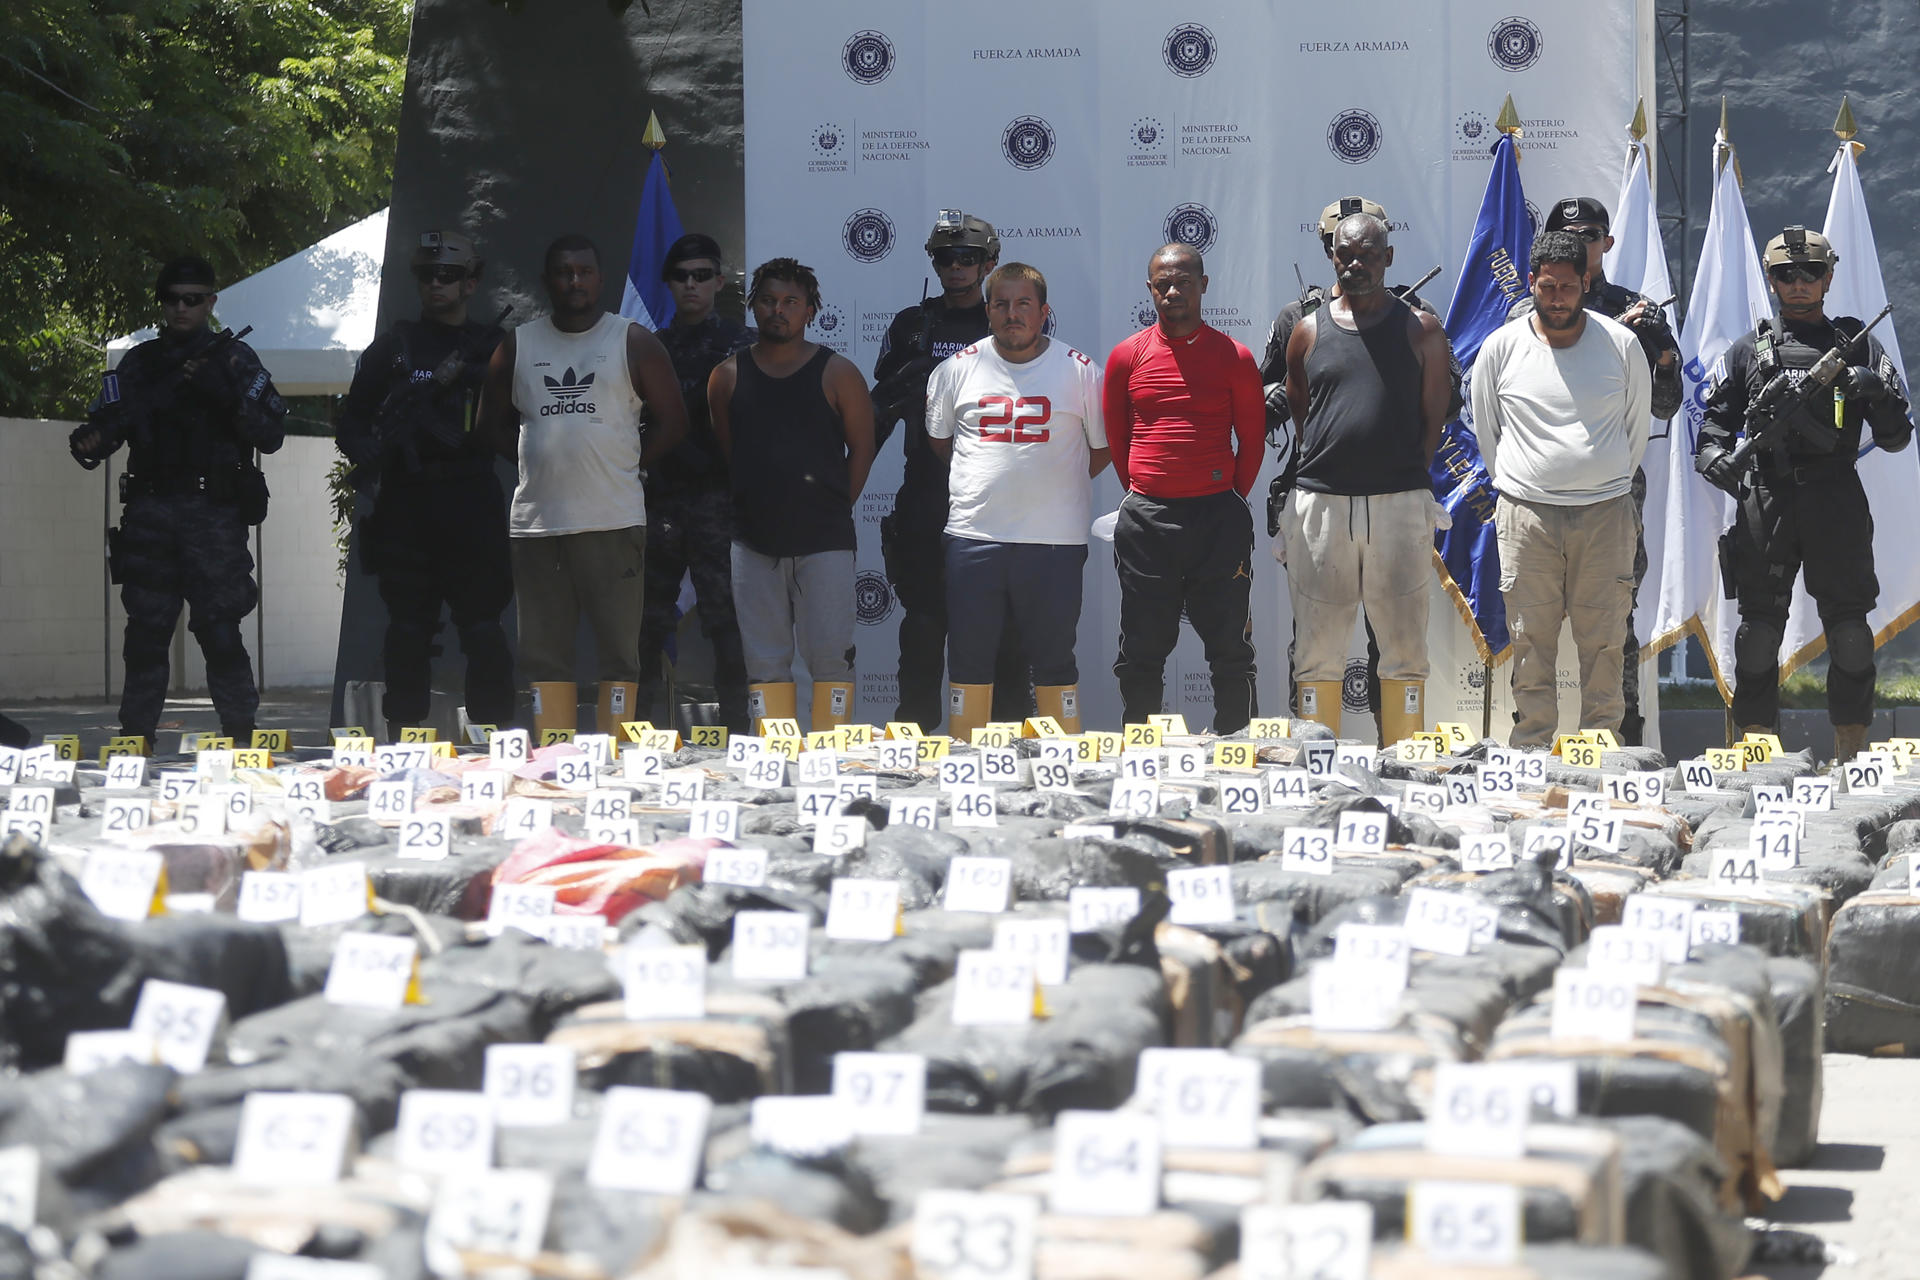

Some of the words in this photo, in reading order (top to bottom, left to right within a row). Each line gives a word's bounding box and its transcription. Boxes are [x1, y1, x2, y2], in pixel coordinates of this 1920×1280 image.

[973, 49, 1023, 60] FUERZA
[1026, 47, 1082, 58] ARMADA
[1299, 42, 1350, 53] FUERZA
[1353, 40, 1410, 51] ARMADA
[1182, 124, 1238, 133] MINISTERIO
[1519, 119, 1565, 127] NISTERIO
[862, 130, 917, 139] MINISTERIO
[862, 142, 874, 150] DE
[876, 142, 888, 150] LA
[890, 141, 930, 150] DEFENSA
[1182, 136, 1194, 144] DE
[1196, 136, 1208, 144] LA
[1210, 135, 1252, 144] DEFENSA
[1516, 141, 1558, 150] ACIONAL
[1537, 130, 1579, 139] DEFENSA
[862, 152, 911, 161] NACIONAL
[1182, 147, 1232, 156] NACIONAL
[1026, 226, 1082, 238] ARMADA
[1486, 247, 1526, 303] FUERZA
[862, 312, 897, 320] MINIST
[1201, 307, 1239, 316] ISTERIO
[1211, 319, 1252, 327] DEFENSA
[933, 341, 967, 350] MARIN
[540, 400, 597, 417] adidas
[978, 395, 1052, 443] 22
[863, 493, 896, 501] MINIST
[863, 504, 875, 512] DE
[877, 504, 888, 512] LA
[863, 673, 898, 682] MINISTE
[863, 684, 876, 692] DE
[879, 684, 891, 692] LA
[1184, 684, 1197, 692] DE
[1199, 684, 1211, 692] LA
[863, 695, 899, 704] NACION
[1184, 695, 1214, 704] NACIO
[769, 722, 796, 737] 10
[900, 726, 913, 737] 9
[1039, 720, 1055, 735] 8
[1130, 728, 1155, 745] 26
[1161, 718, 1173, 733] 7
[1256, 722, 1281, 739] 38
[1451, 726, 1465, 742] 5
[257, 733, 280, 750] 20
[495, 736, 524, 760] 13
[645, 734, 669, 751] 42
[697, 729, 721, 747] 23
[769, 740, 793, 758] 56
[814, 735, 838, 750] 41
[977, 732, 1002, 749] 40
[1595, 732, 1609, 748] 4
[236, 752, 260, 768] 53
[883, 747, 913, 769] 35
[917, 740, 942, 759] 57
[1220, 746, 1247, 766] 59
[1404, 743, 1429, 761] 37
[1568, 747, 1595, 766] 36
[1744, 744, 1765, 763] 30
[110, 762, 139, 782] 44
[560, 760, 593, 785] 34
[749, 760, 781, 782] 48
[803, 756, 832, 777] 45
[984, 753, 1017, 775] 58
[1124, 758, 1157, 778] 16
[1179, 753, 1195, 773] 6
[1308, 750, 1335, 775] 57
[1514, 758, 1543, 779] 43
[1711, 753, 1736, 771] 35
[942, 762, 976, 785] 32
[1037, 764, 1070, 787] 39
[1482, 770, 1514, 792] 53
[1685, 765, 1714, 788] 40
[1849, 766, 1880, 789] 20
[163, 778, 198, 800] 57
[287, 781, 321, 801] 43
[463, 781, 496, 801] 14
[665, 781, 699, 807] 54
[839, 784, 873, 801] 55
[1272, 777, 1306, 799] 44
[1451, 781, 1478, 805] 31
[1608, 779, 1640, 804] 16
[1796, 784, 1830, 805] 37
[374, 788, 406, 813] 48
[590, 798, 627, 820] 48
[802, 794, 838, 817] 47
[956, 793, 993, 817] 46
[1113, 788, 1153, 817] 43
[1224, 786, 1260, 813] 29
[1410, 791, 1445, 814] 59
[107, 806, 145, 831] 20
[519, 808, 537, 832] 4
[701, 809, 731, 834] 19
[897, 805, 931, 830] 16
[405, 821, 444, 848] 23
[831, 824, 849, 848] 5
[1342, 821, 1381, 846] 18
[1581, 815, 1616, 844] 51
[1287, 836, 1329, 863] 43
[1467, 841, 1507, 865] 42
[1755, 833, 1791, 859] 14
[714, 860, 759, 884] 159
[958, 865, 1004, 889] 160
[1718, 858, 1760, 885] 44
[252, 881, 297, 902] 157
[1177, 875, 1224, 900] 161
[502, 893, 548, 917] 158
[1418, 899, 1470, 928] 135
[1633, 907, 1684, 933] 134
[746, 925, 798, 949] 130
[1701, 921, 1732, 943] 63
[1348, 936, 1402, 961] 132
[969, 965, 1029, 990] 102
[1567, 983, 1628, 1010] 100
[154, 1002, 203, 1044] 95
[499, 1062, 558, 1099] 96
[849, 1070, 906, 1105] 97
[1177, 1074, 1244, 1117] 67
[1448, 1083, 1512, 1127] 66
[418, 1112, 481, 1152] 69
[1073, 1132, 1142, 1181] 64
[1428, 1200, 1503, 1251] 65
[929, 1211, 1018, 1276] 33
